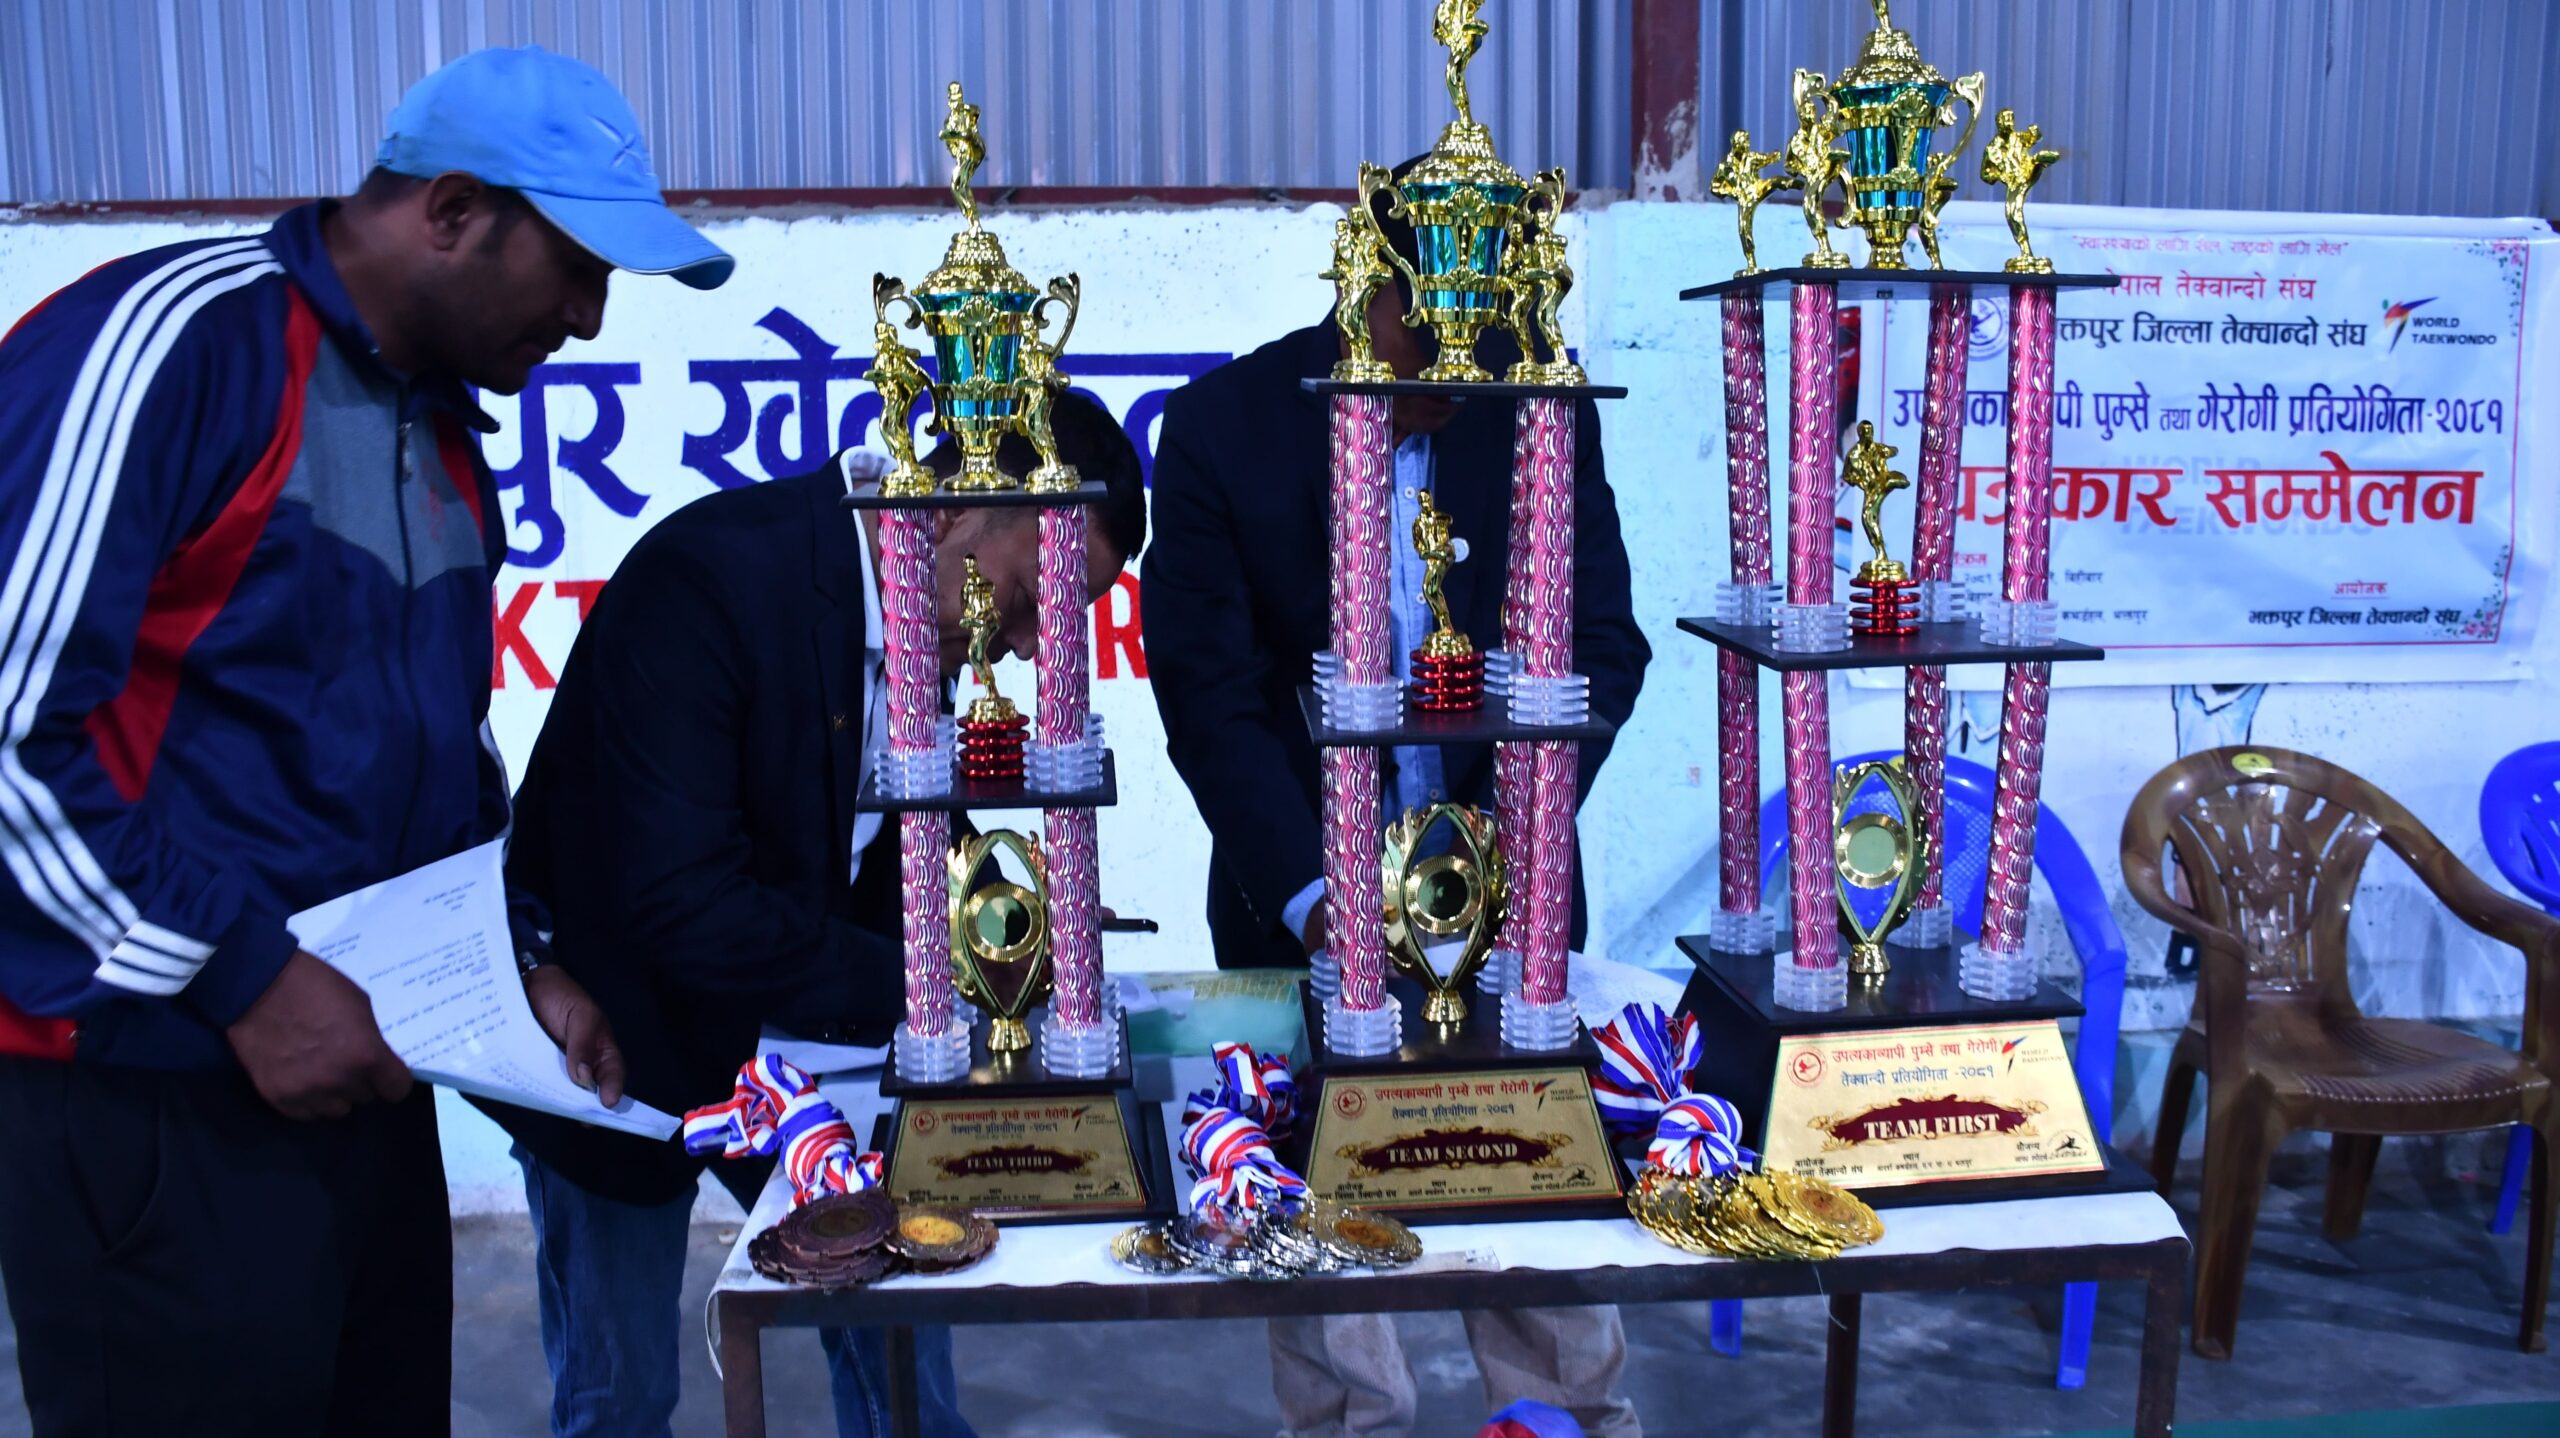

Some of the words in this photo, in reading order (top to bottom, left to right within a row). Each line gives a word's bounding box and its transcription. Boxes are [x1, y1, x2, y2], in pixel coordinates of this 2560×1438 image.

[2176, 270, 2266, 300] तेक्वान्दो
[2278, 273, 2317, 300] संघ
[2056, 317, 2124, 348] क्तपुर
[2133, 311, 2212, 344] जिल्ला
[2220, 315, 2319, 346] तेक्वान्दो
[2327, 318, 2368, 347] संघ
[2412, 318, 2460, 328] WORLD
[2412, 334, 2497, 345] TAEKWONDO
[2093, 382, 2151, 440] पुम्से
[2160, 409, 2191, 431] तथा
[2198, 382, 2279, 433] गेरोगी
[2204, 450, 2484, 528] सम्मेलन
[2248, 609, 2304, 628] भक्तपुर
[2308, 606, 2361, 625] जिल्ला
[2366, 606, 2431, 626] तेक्वान्दो
[2434, 607, 2461, 626] संघ
[1940, 1041, 1961, 1058] तथा
[1863, 1118, 1929, 1140] TEAM
[1933, 1112, 2001, 1135] FIRST
[967, 1157, 1003, 1169] TEAM
[1009, 1156, 1053, 1169] THIRD
[1386, 1147, 1440, 1163] TEAM
[1445, 1143, 1518, 1162] SECOND
